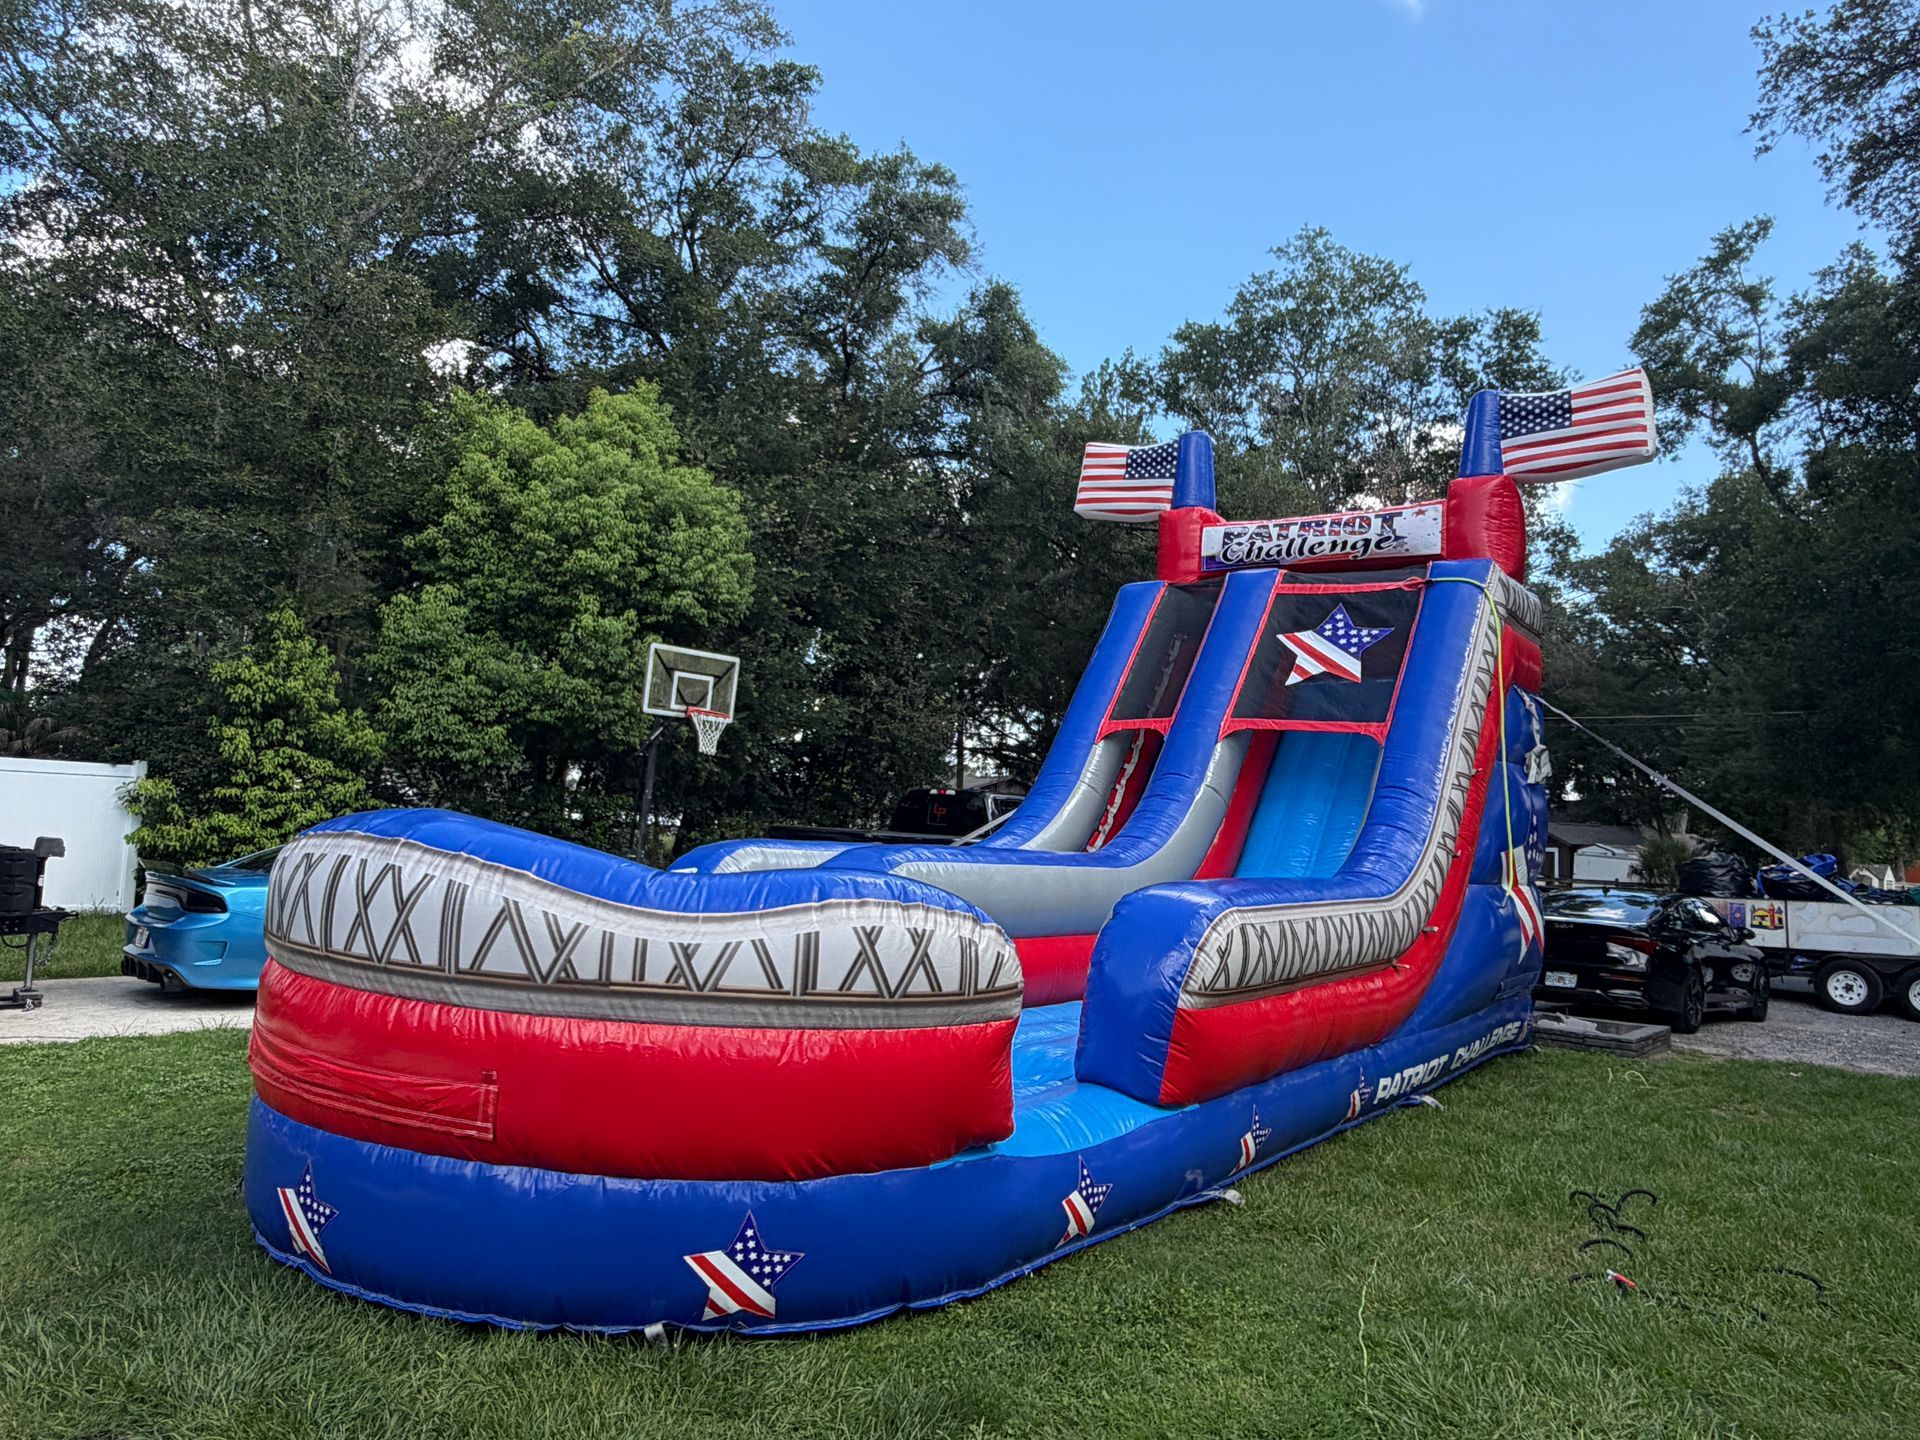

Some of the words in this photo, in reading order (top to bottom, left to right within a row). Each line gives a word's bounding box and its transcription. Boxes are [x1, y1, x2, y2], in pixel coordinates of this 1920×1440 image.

[1222, 512, 1403, 548] PATRIOT
[1220, 533, 1396, 564] Challenge
[1373, 1054, 1449, 1104] PATRIOT
[1450, 1021, 1521, 1070] CHALLENGE
